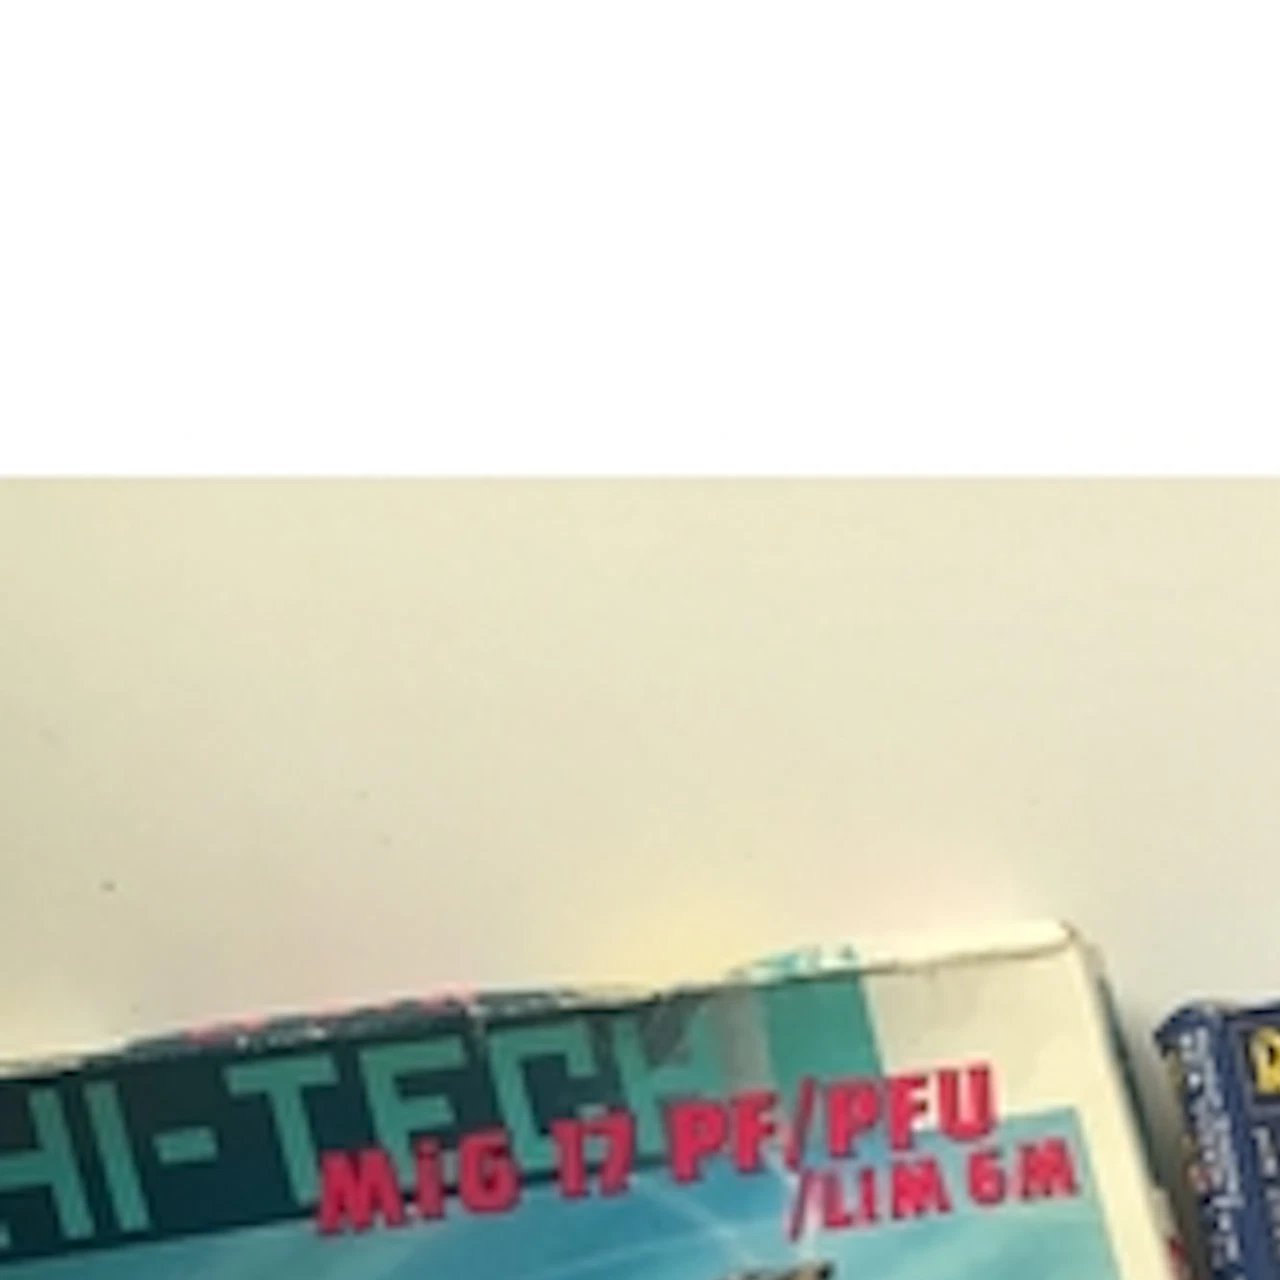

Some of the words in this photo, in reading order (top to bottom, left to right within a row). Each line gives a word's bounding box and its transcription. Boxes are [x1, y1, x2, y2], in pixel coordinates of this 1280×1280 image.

[315, 1125, 523, 1236] MiG
[548, 1108, 634, 1200] 17
[664, 1062, 995, 1184] PF/PFU
